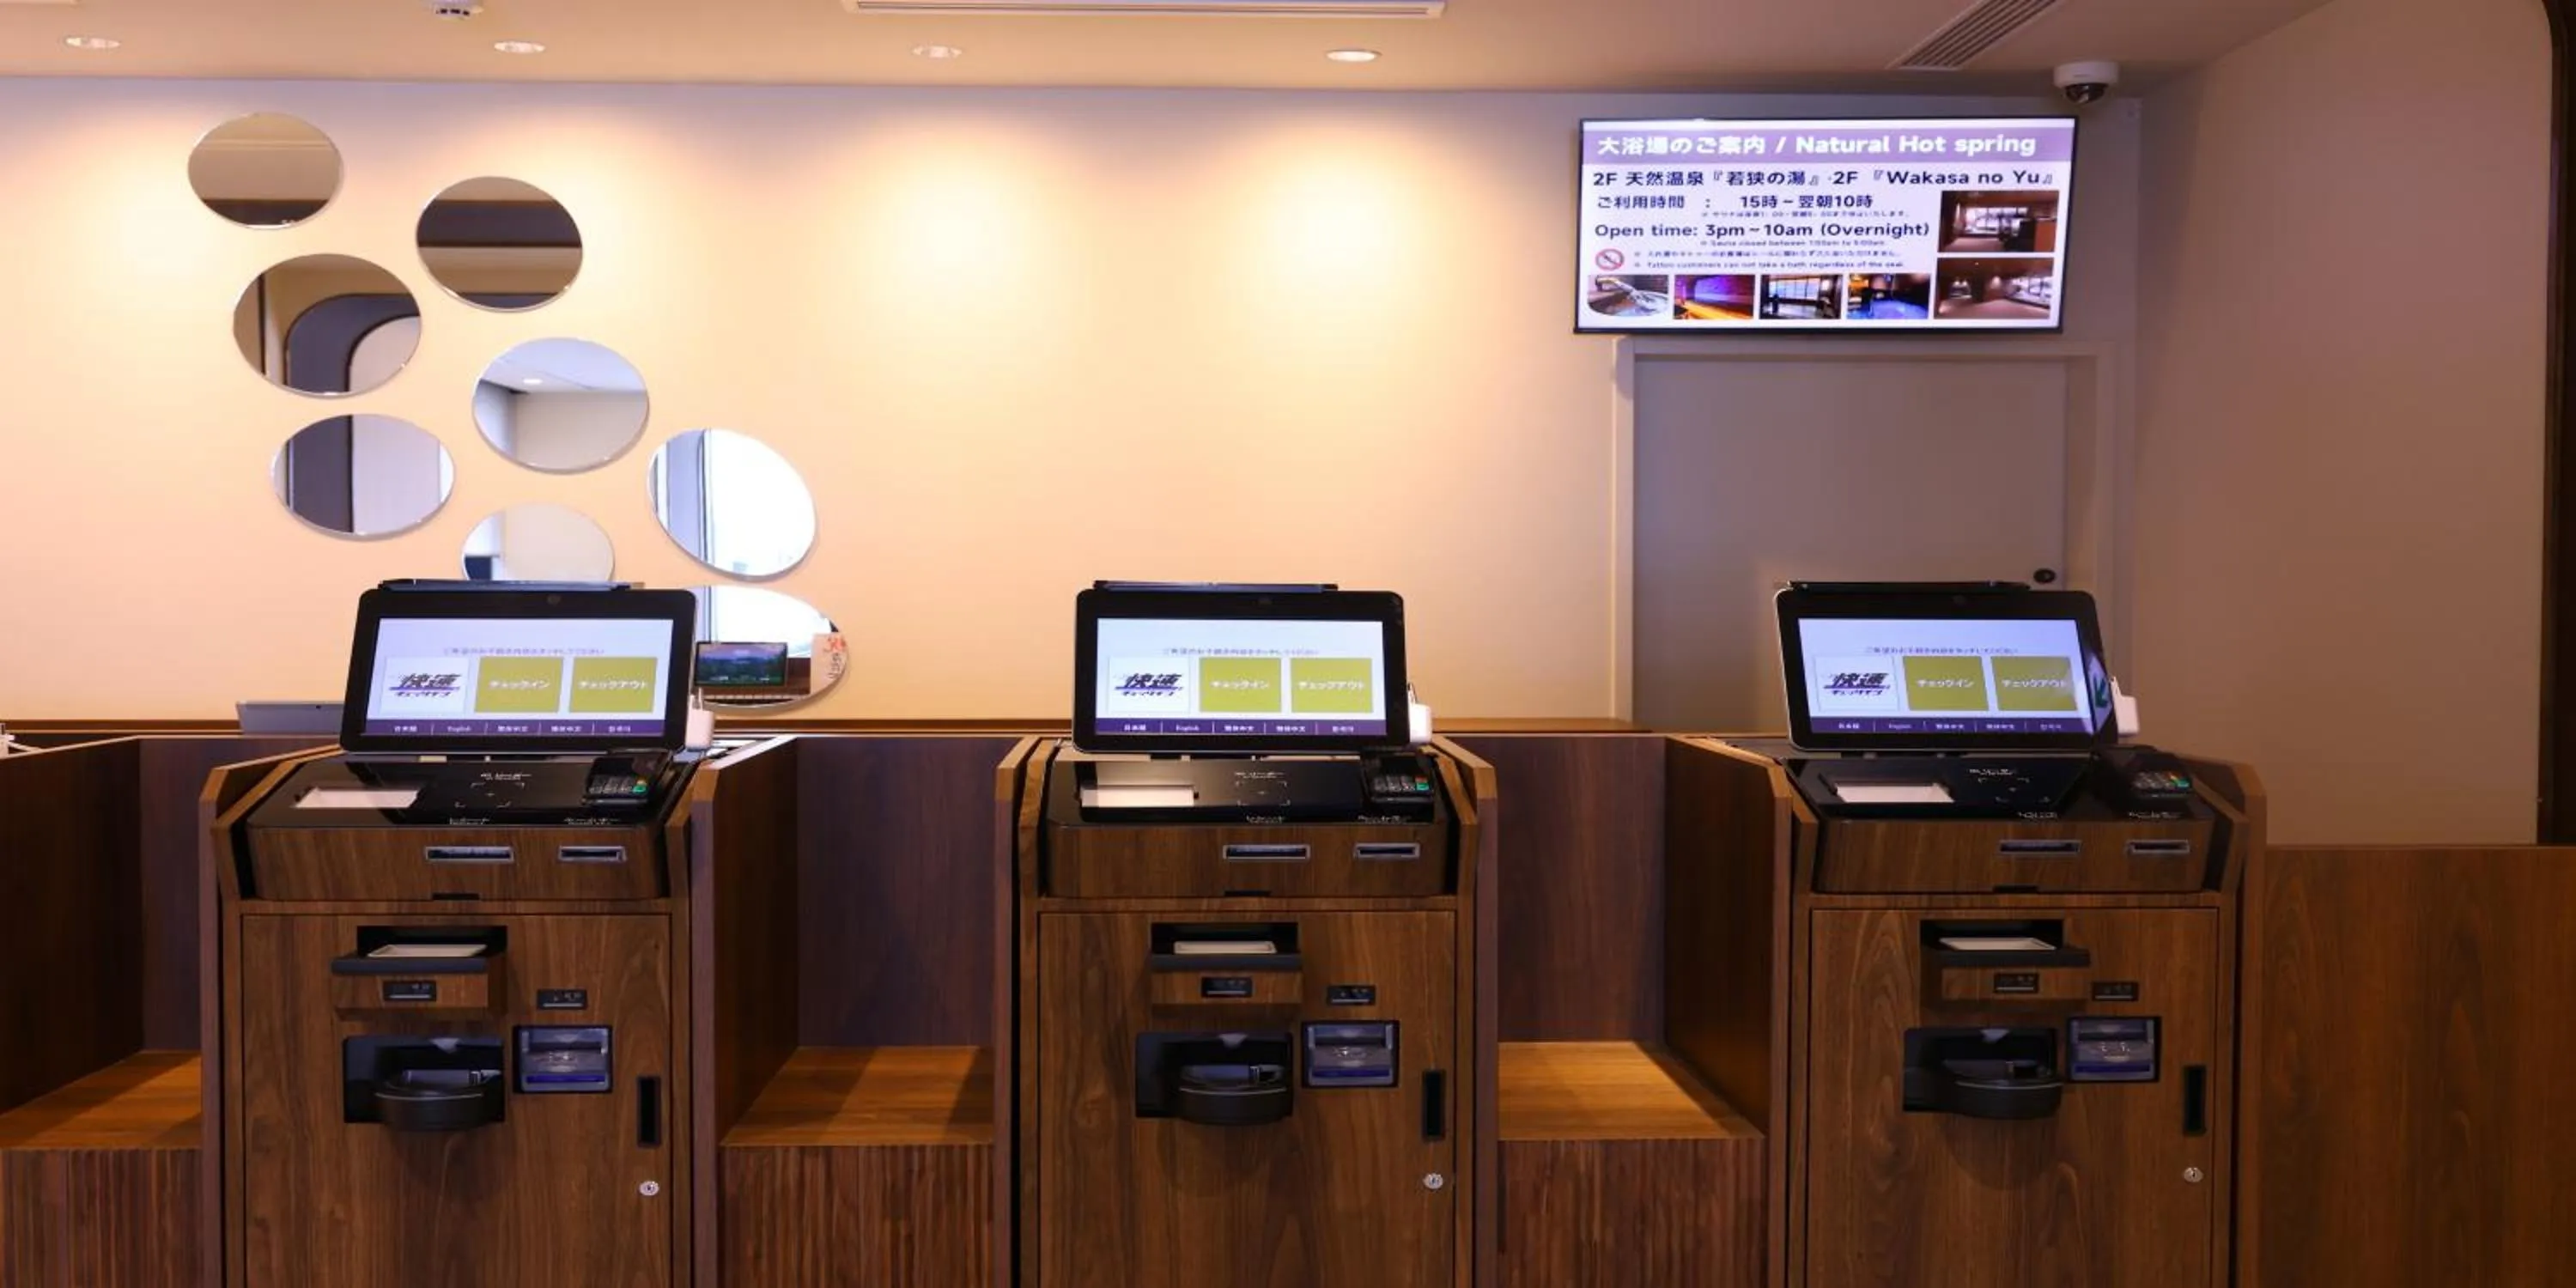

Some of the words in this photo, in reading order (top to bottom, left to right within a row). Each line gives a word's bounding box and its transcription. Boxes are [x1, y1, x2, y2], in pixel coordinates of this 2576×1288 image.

[1597, 136, 1765, 155] 大浴場のご案内
[1795, 136, 1890, 154] Natural
[1899, 135, 1947, 153] Hot
[1954, 134, 2037, 157] spring
[1593, 172, 1619, 186] 2F
[1978, 173, 2004, 185] no
[1595, 223, 1644, 240] Open
[1651, 223, 1698, 237] time:
[1820, 222, 1930, 240] (Overnight)
